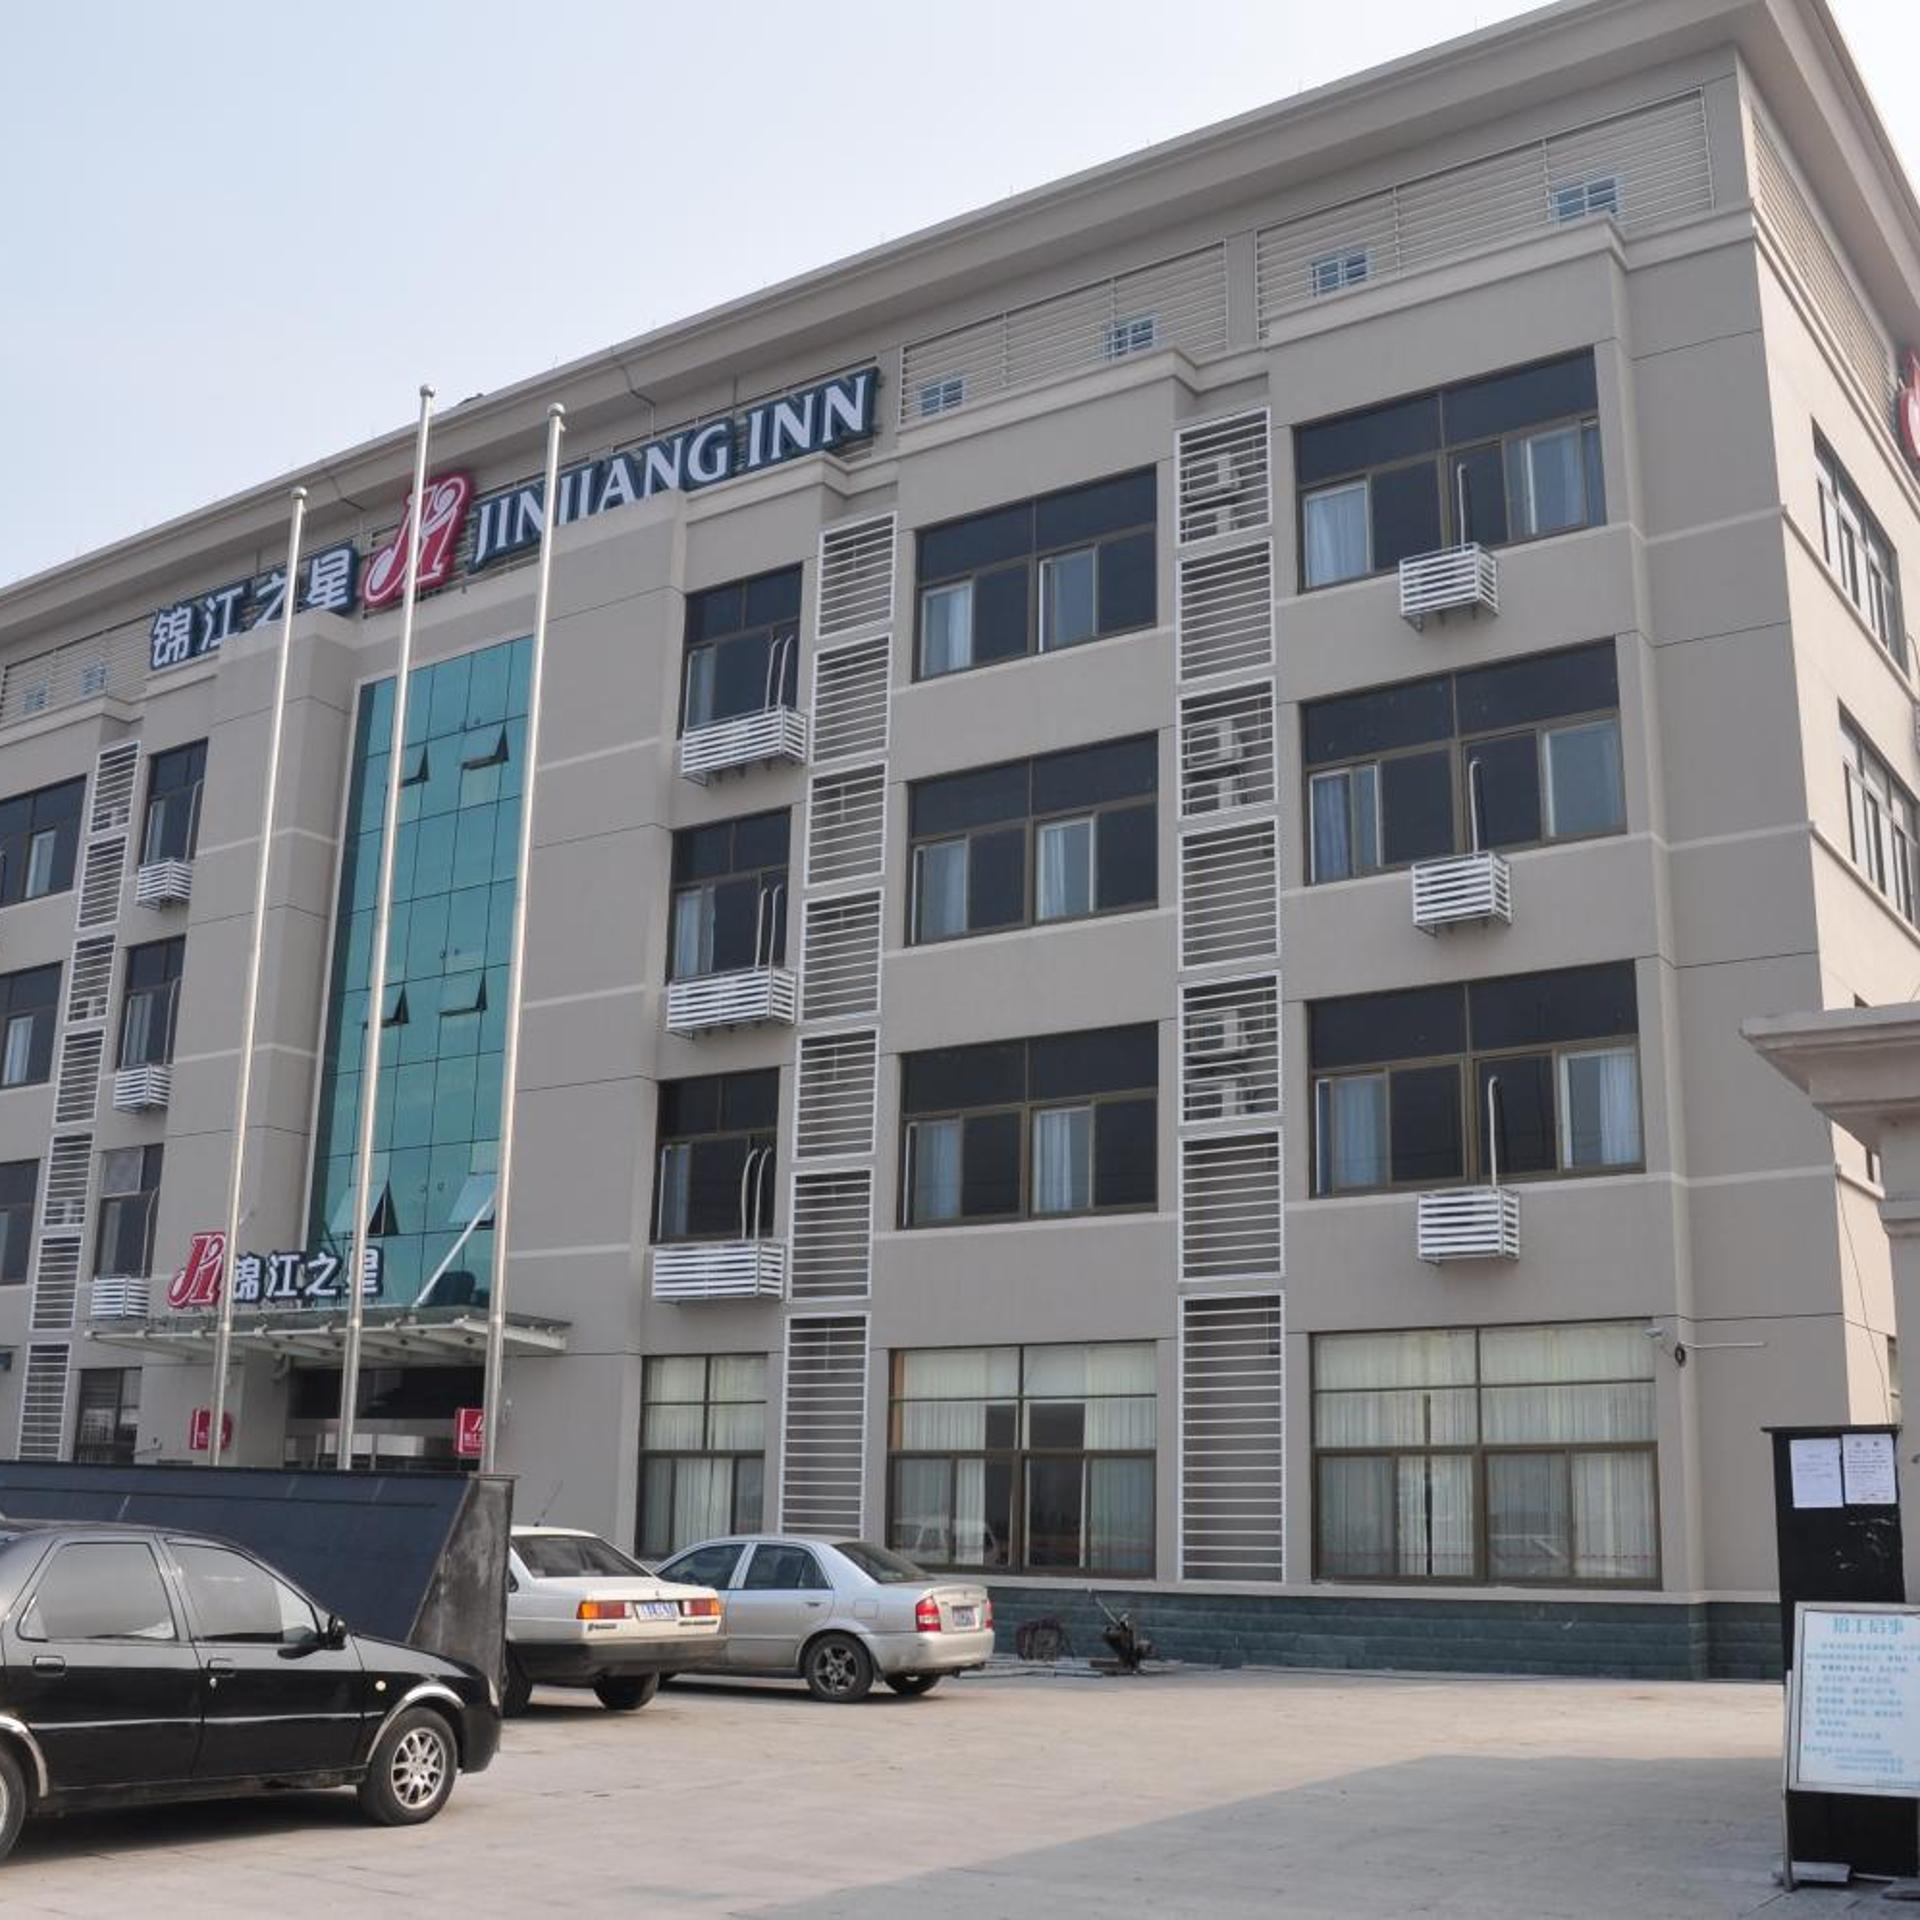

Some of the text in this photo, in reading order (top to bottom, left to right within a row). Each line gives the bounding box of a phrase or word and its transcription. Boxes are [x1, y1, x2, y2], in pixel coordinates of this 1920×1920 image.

[748, 375, 866, 468] INN
[153, 548, 351, 667] 锦江之星
